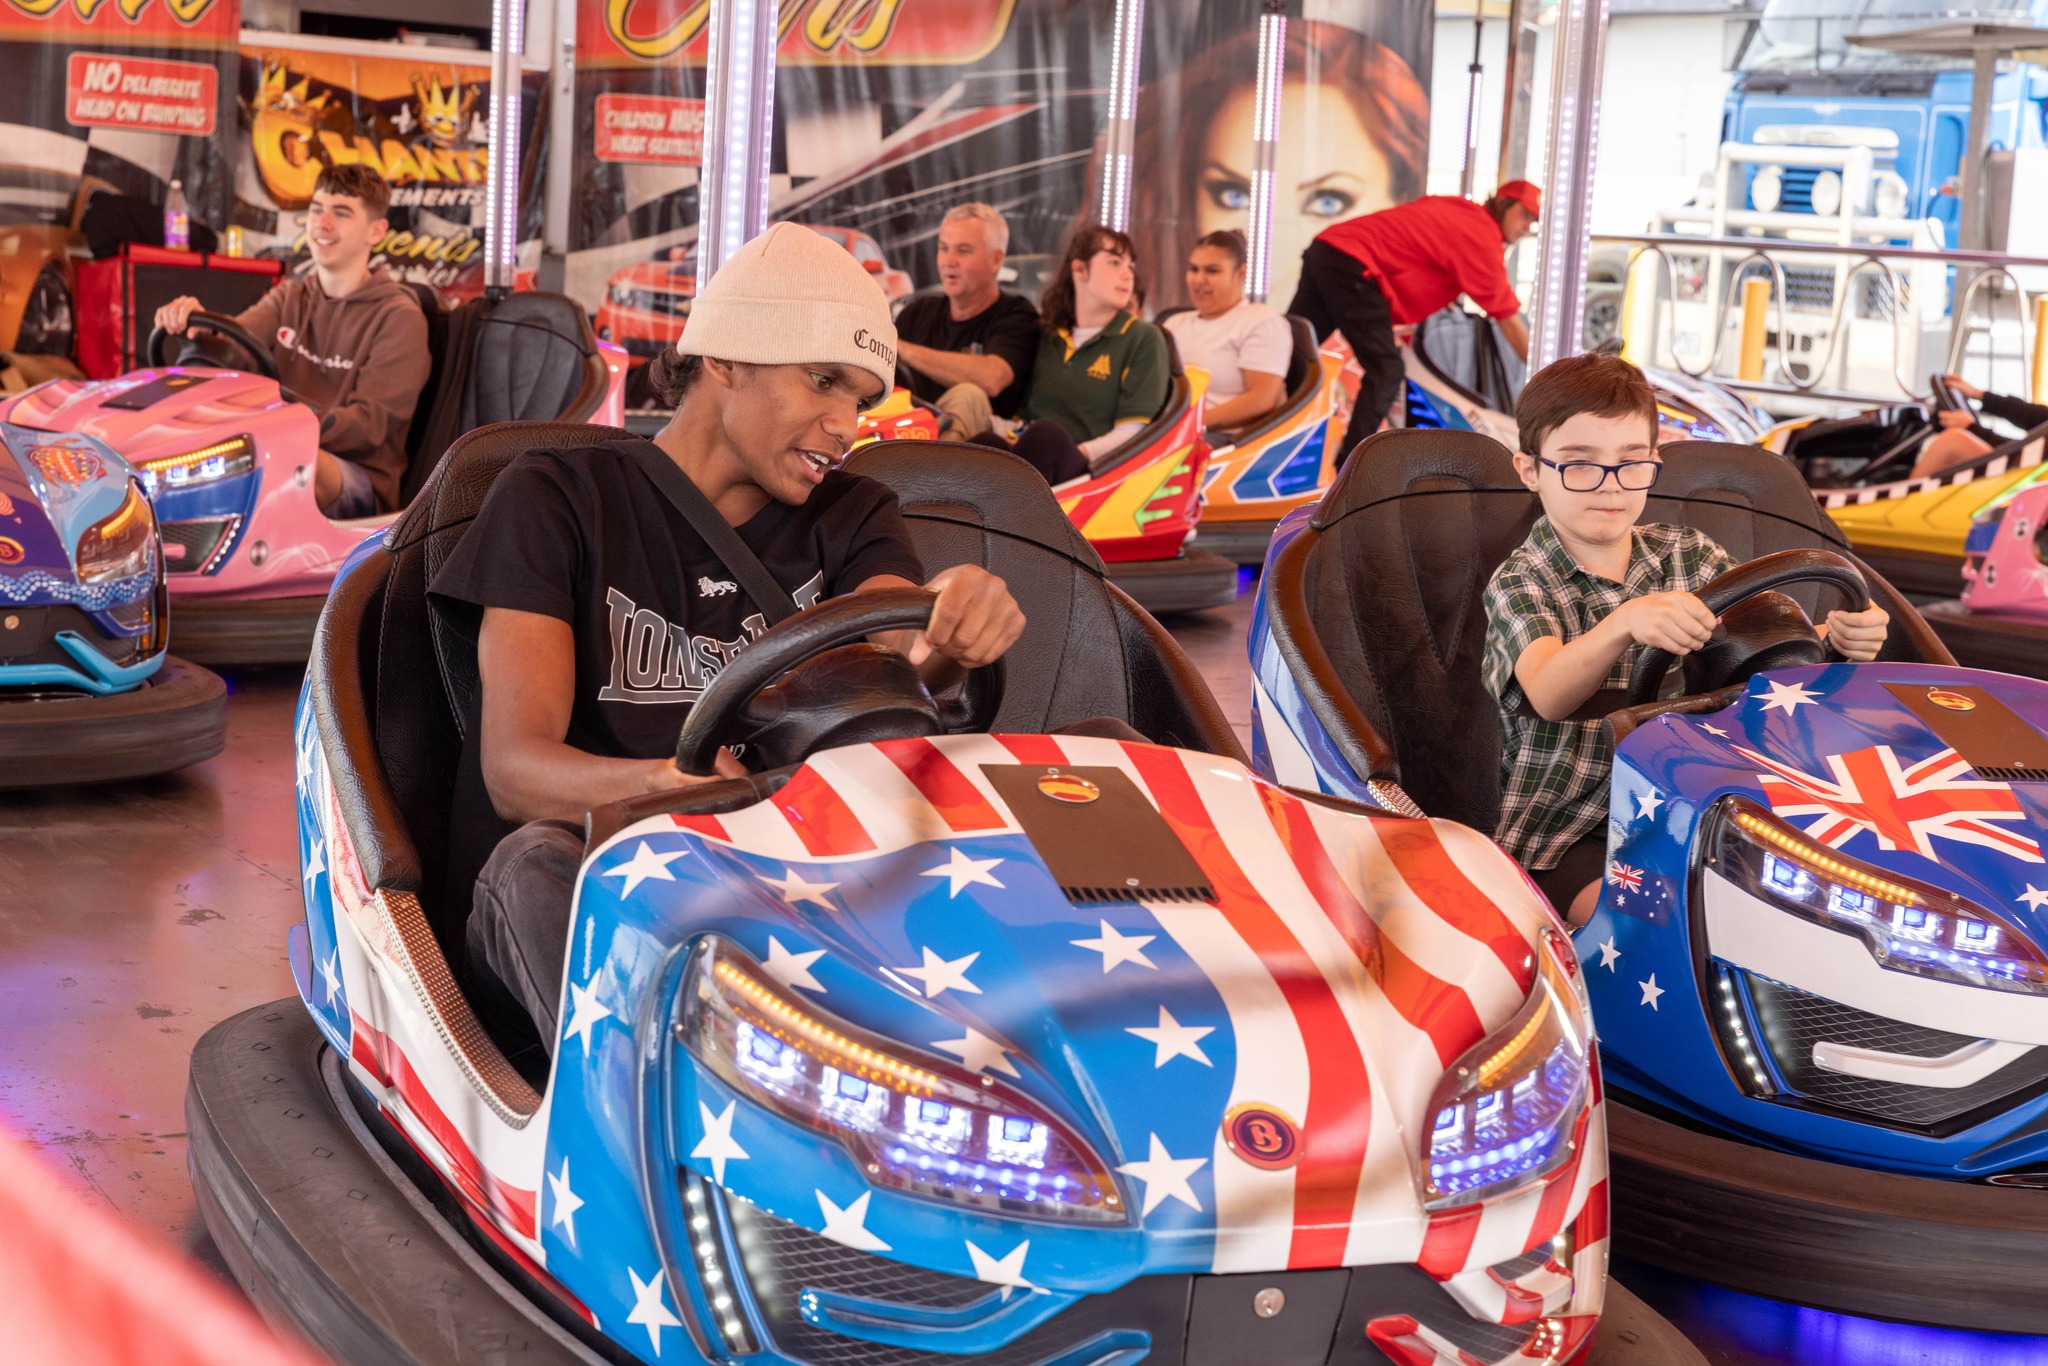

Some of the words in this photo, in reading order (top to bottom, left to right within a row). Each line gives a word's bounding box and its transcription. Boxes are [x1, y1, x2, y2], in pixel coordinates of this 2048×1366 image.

[83, 61, 122, 93] NO
[75, 97, 116, 120] HEAD
[115, 100, 141, 122] ON
[669, 108, 704, 135] MUS
[854, 328, 895, 369] Comp
